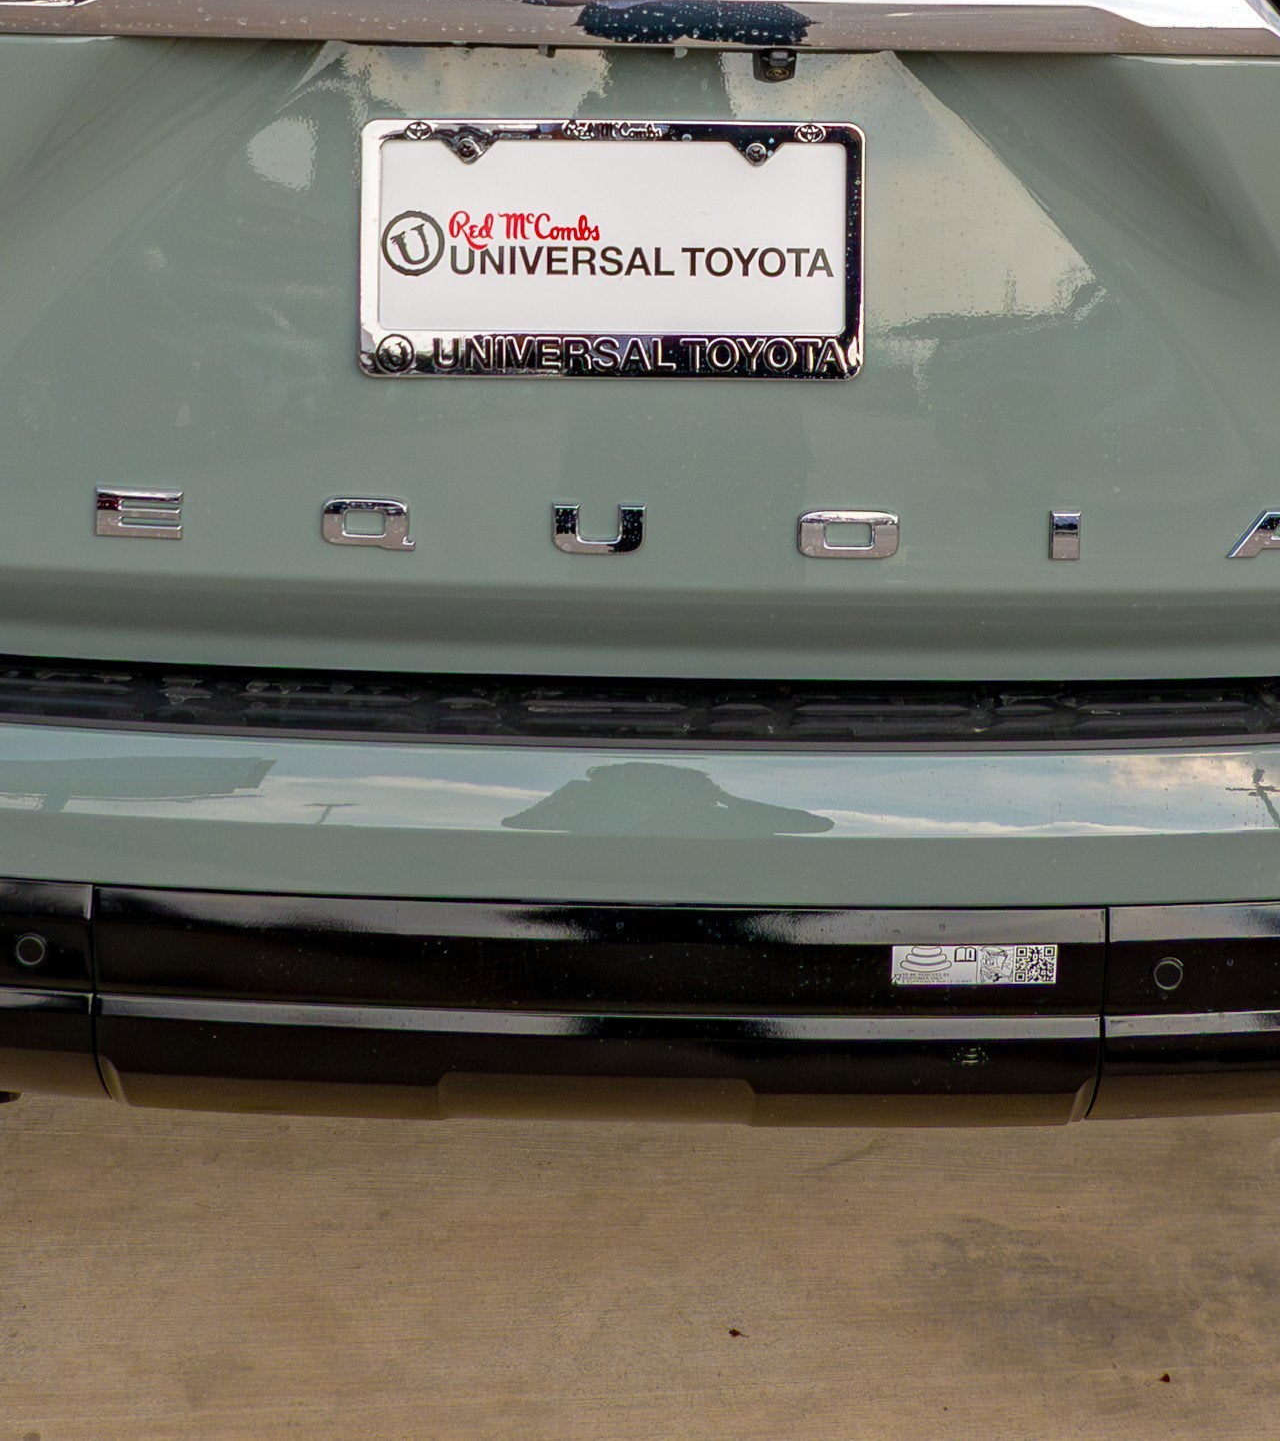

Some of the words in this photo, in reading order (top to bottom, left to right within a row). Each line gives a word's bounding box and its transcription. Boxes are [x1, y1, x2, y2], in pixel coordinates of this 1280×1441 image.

[449, 211, 495, 250] Red
[498, 212, 600, 241] McCombs
[450, 245, 675, 277] UNIVERSAL
[681, 246, 834, 278] TOYOTA
[433, 337, 676, 373] UNIVERSAL
[681, 338, 852, 374] TOYOTA
